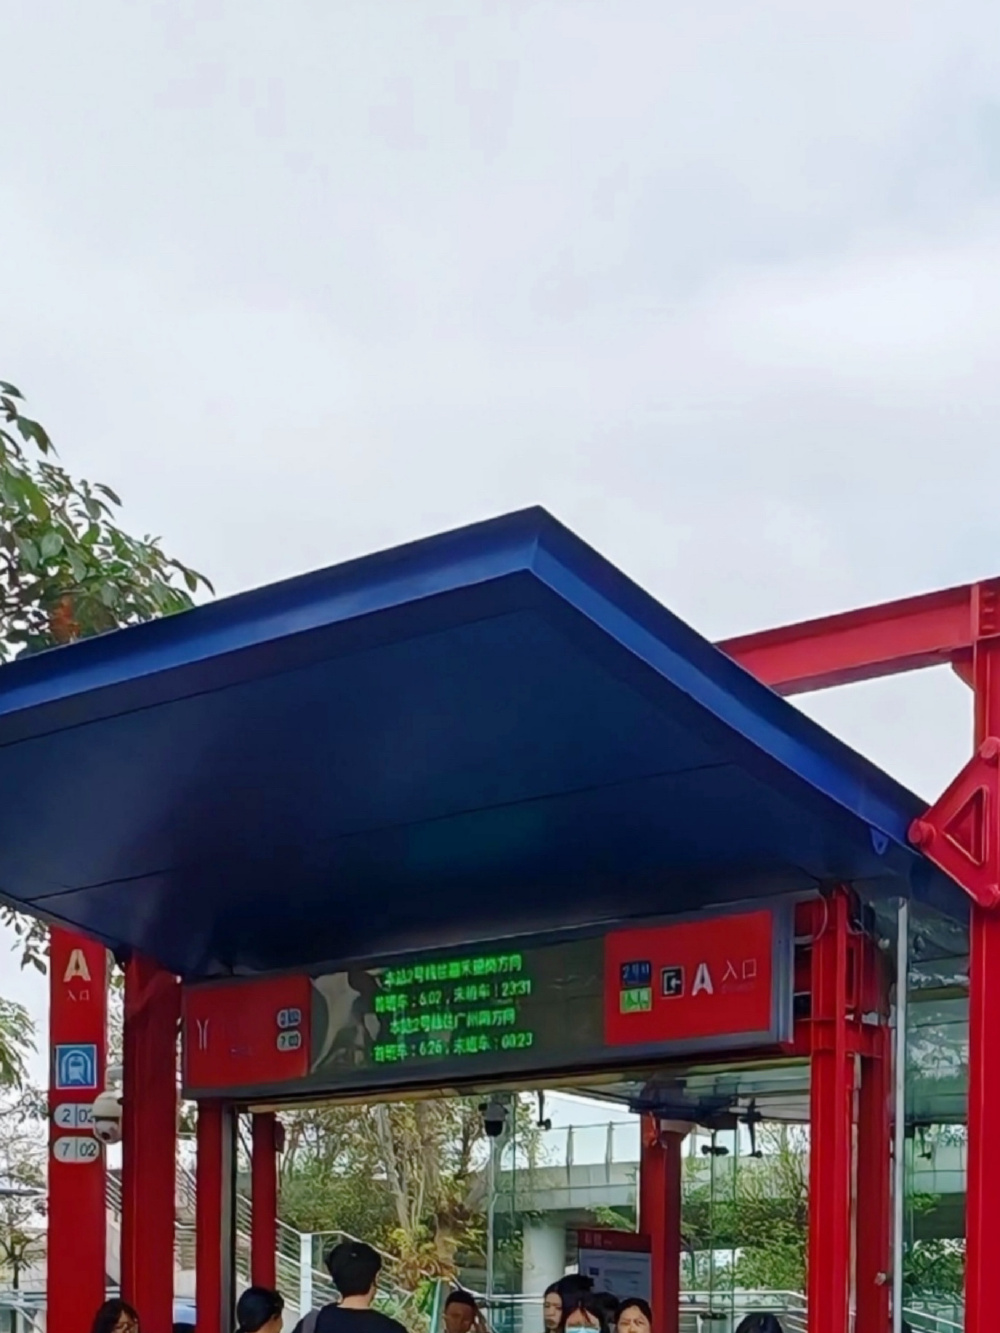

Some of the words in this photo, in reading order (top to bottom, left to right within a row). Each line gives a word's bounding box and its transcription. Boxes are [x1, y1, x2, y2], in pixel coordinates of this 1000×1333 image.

[63, 948, 91, 982] A
[722, 958, 757, 983] 入口
[692, 962, 714, 996] A
[62, 1108, 71, 1123] 2
[62, 1142, 71, 1157] 7
[80, 1142, 97, 1157] 02
